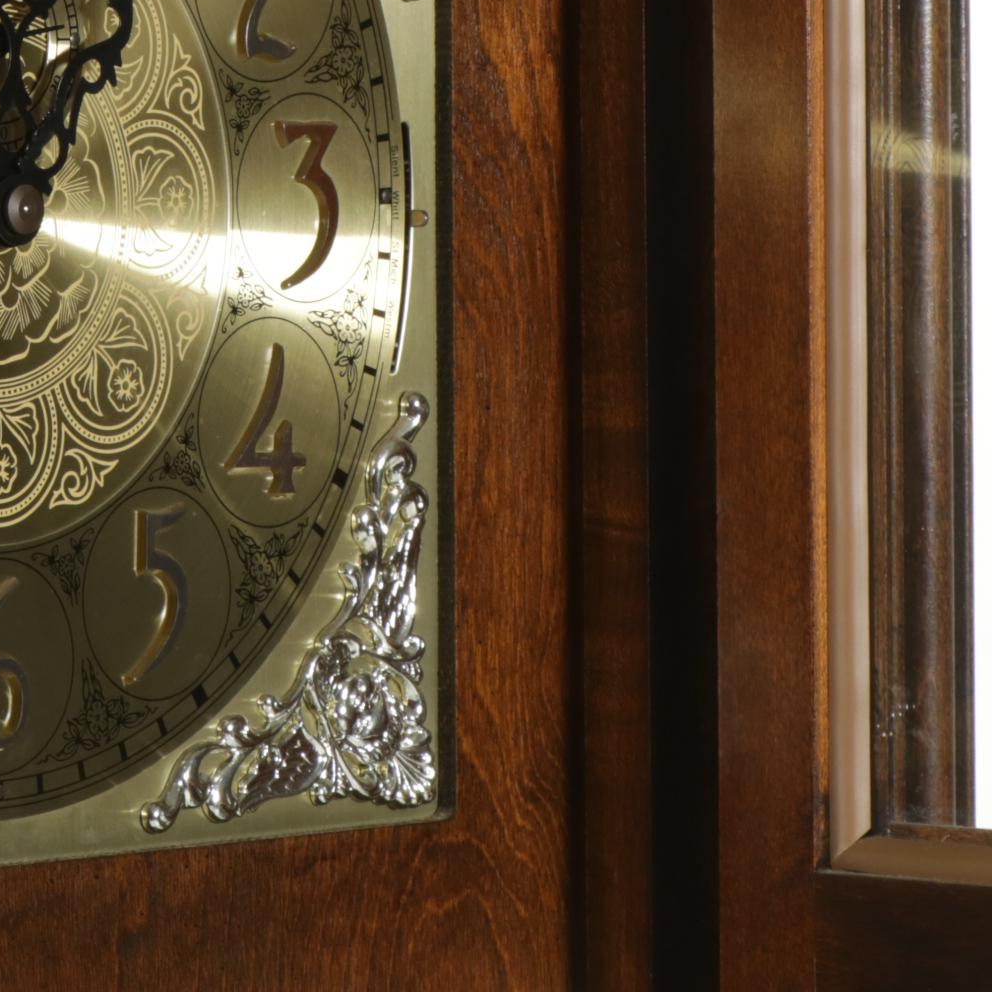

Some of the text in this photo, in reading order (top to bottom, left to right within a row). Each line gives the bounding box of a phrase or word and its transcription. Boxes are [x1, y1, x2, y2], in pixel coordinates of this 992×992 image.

[270, 119, 340, 290] 3
[390, 144, 400, 179] Silent
[220, 341, 307, 498] 4
[119, 501, 190, 687] 5
